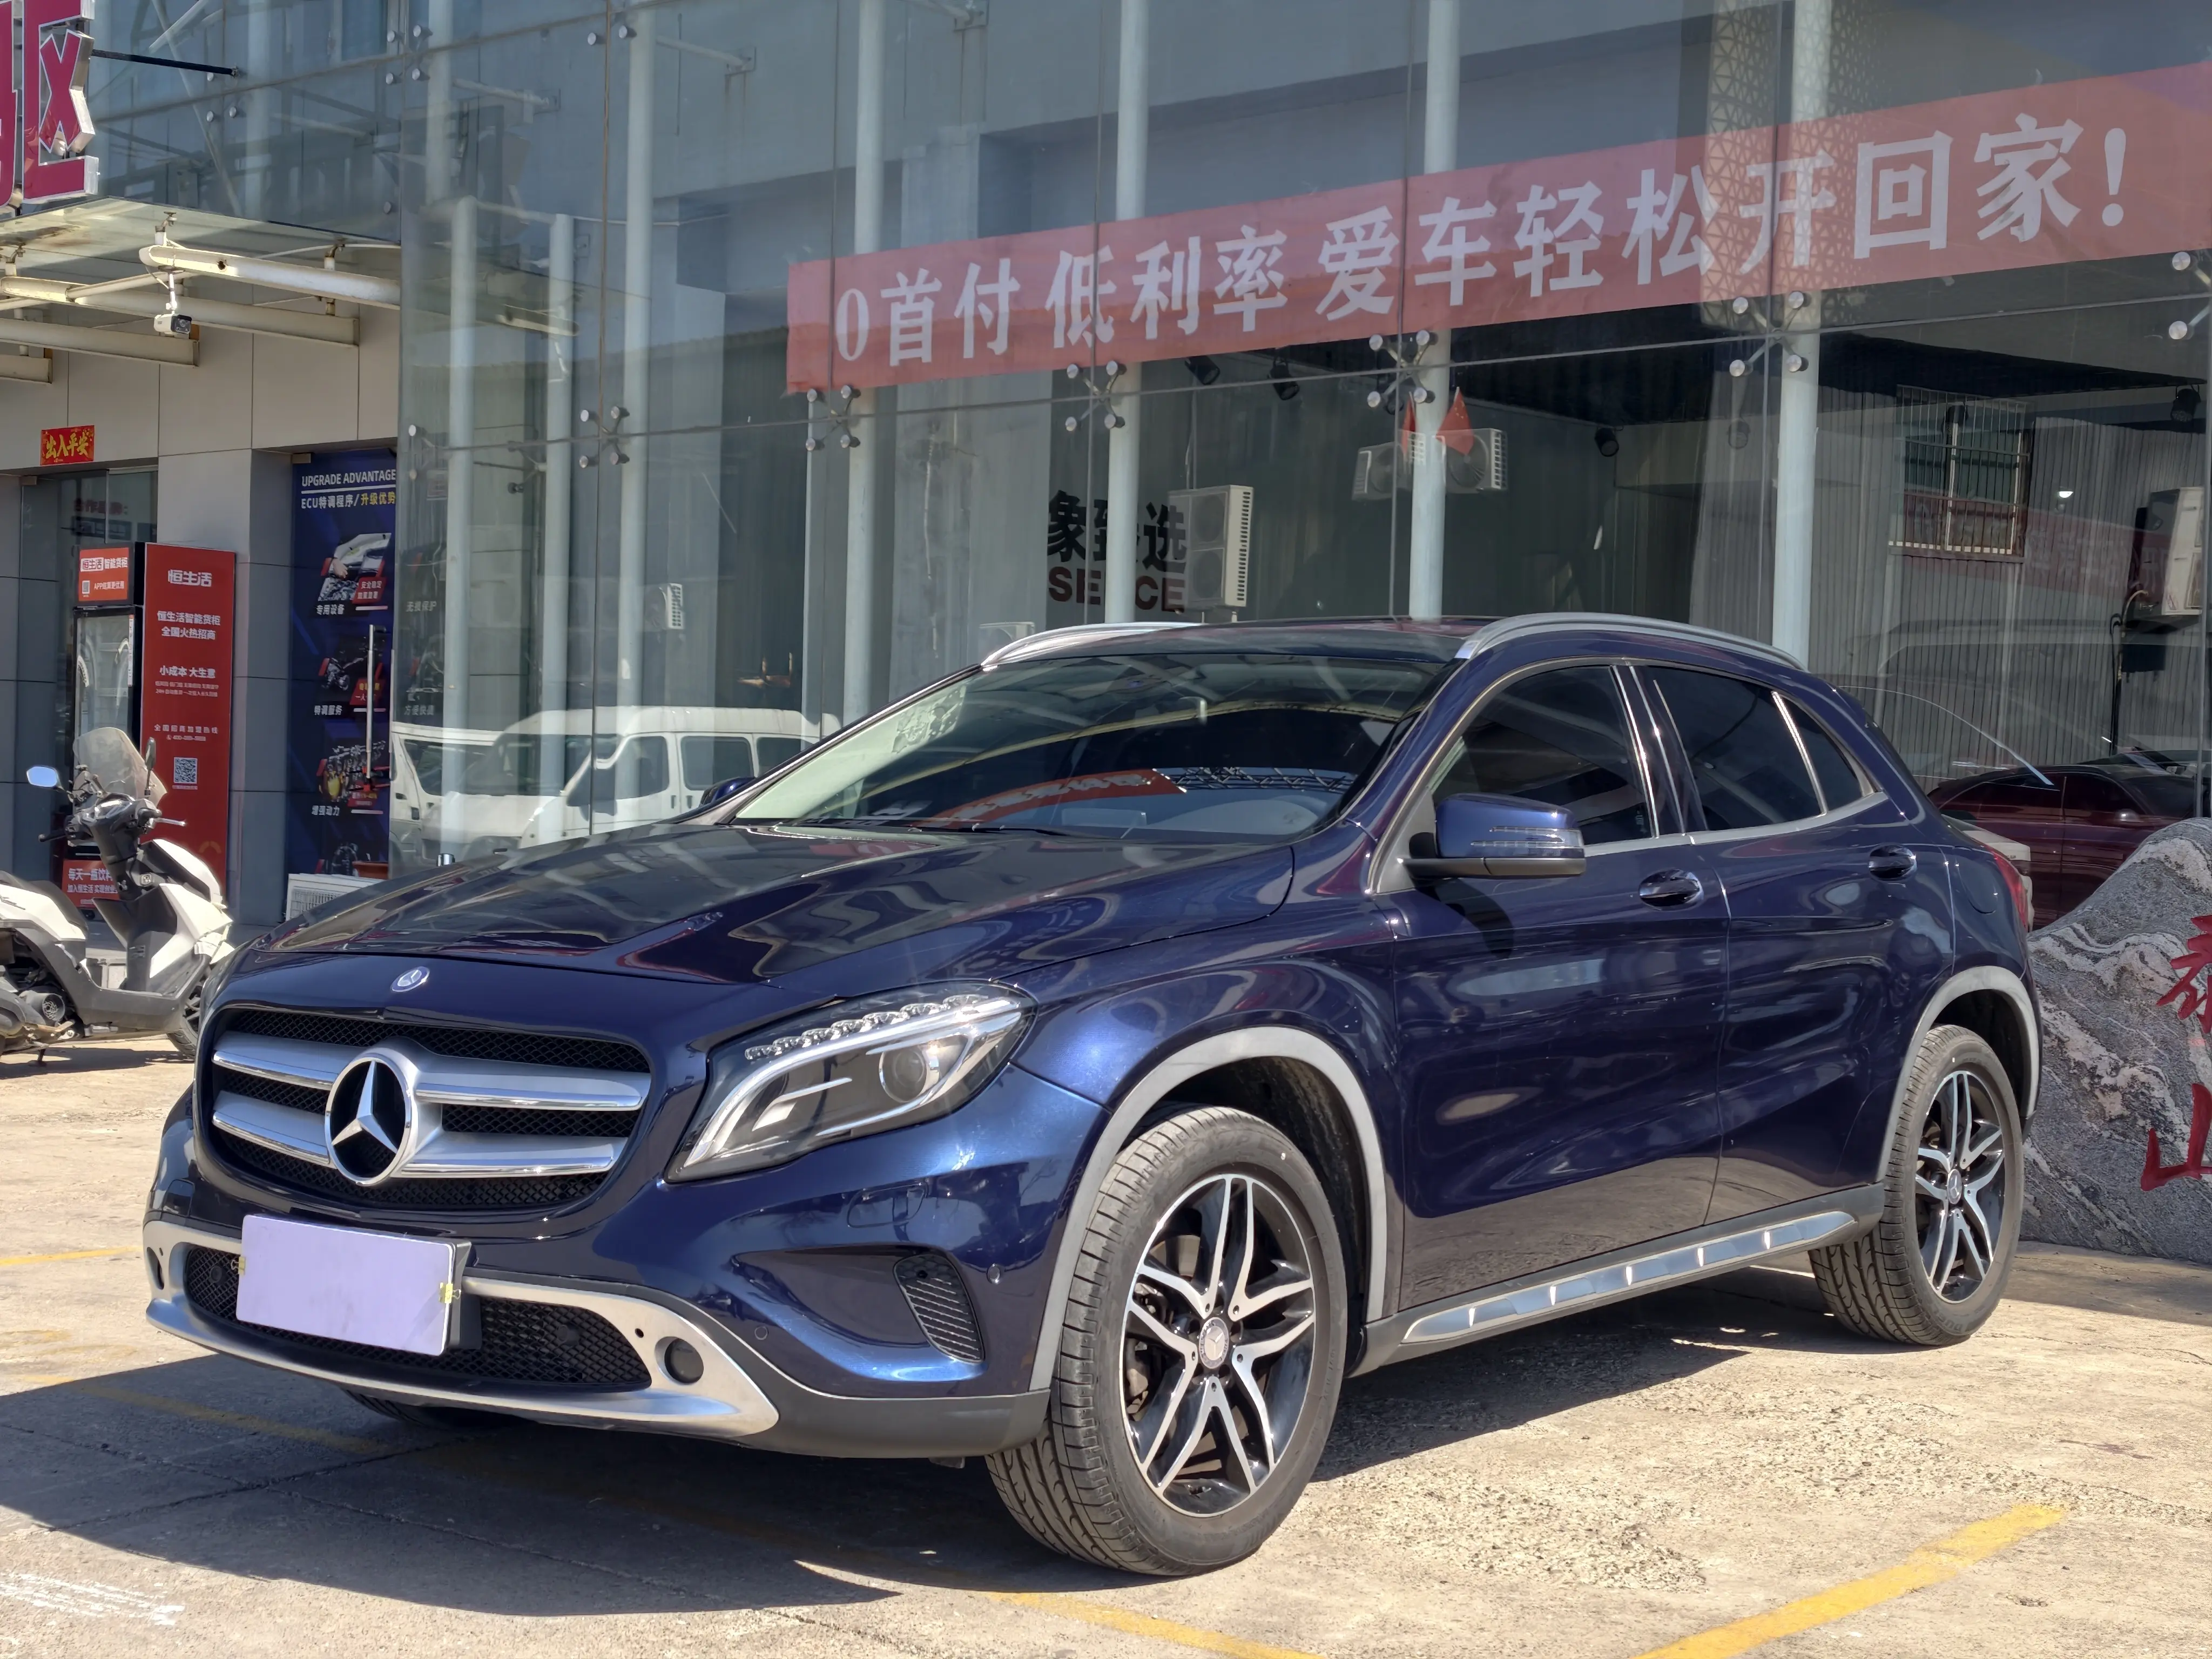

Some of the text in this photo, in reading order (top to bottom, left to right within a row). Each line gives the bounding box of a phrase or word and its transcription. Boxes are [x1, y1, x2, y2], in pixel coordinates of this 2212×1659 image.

[836, 112, 2127, 367] 0首付 低利率 爱车轻松开回家!
[45, 432, 89, 458] 出入平安
[302, 469, 396, 487] UPGRADE ADVANTAGE
[168, 569, 212, 587] 恒生活
[1048, 567, 1185, 612] SECE
